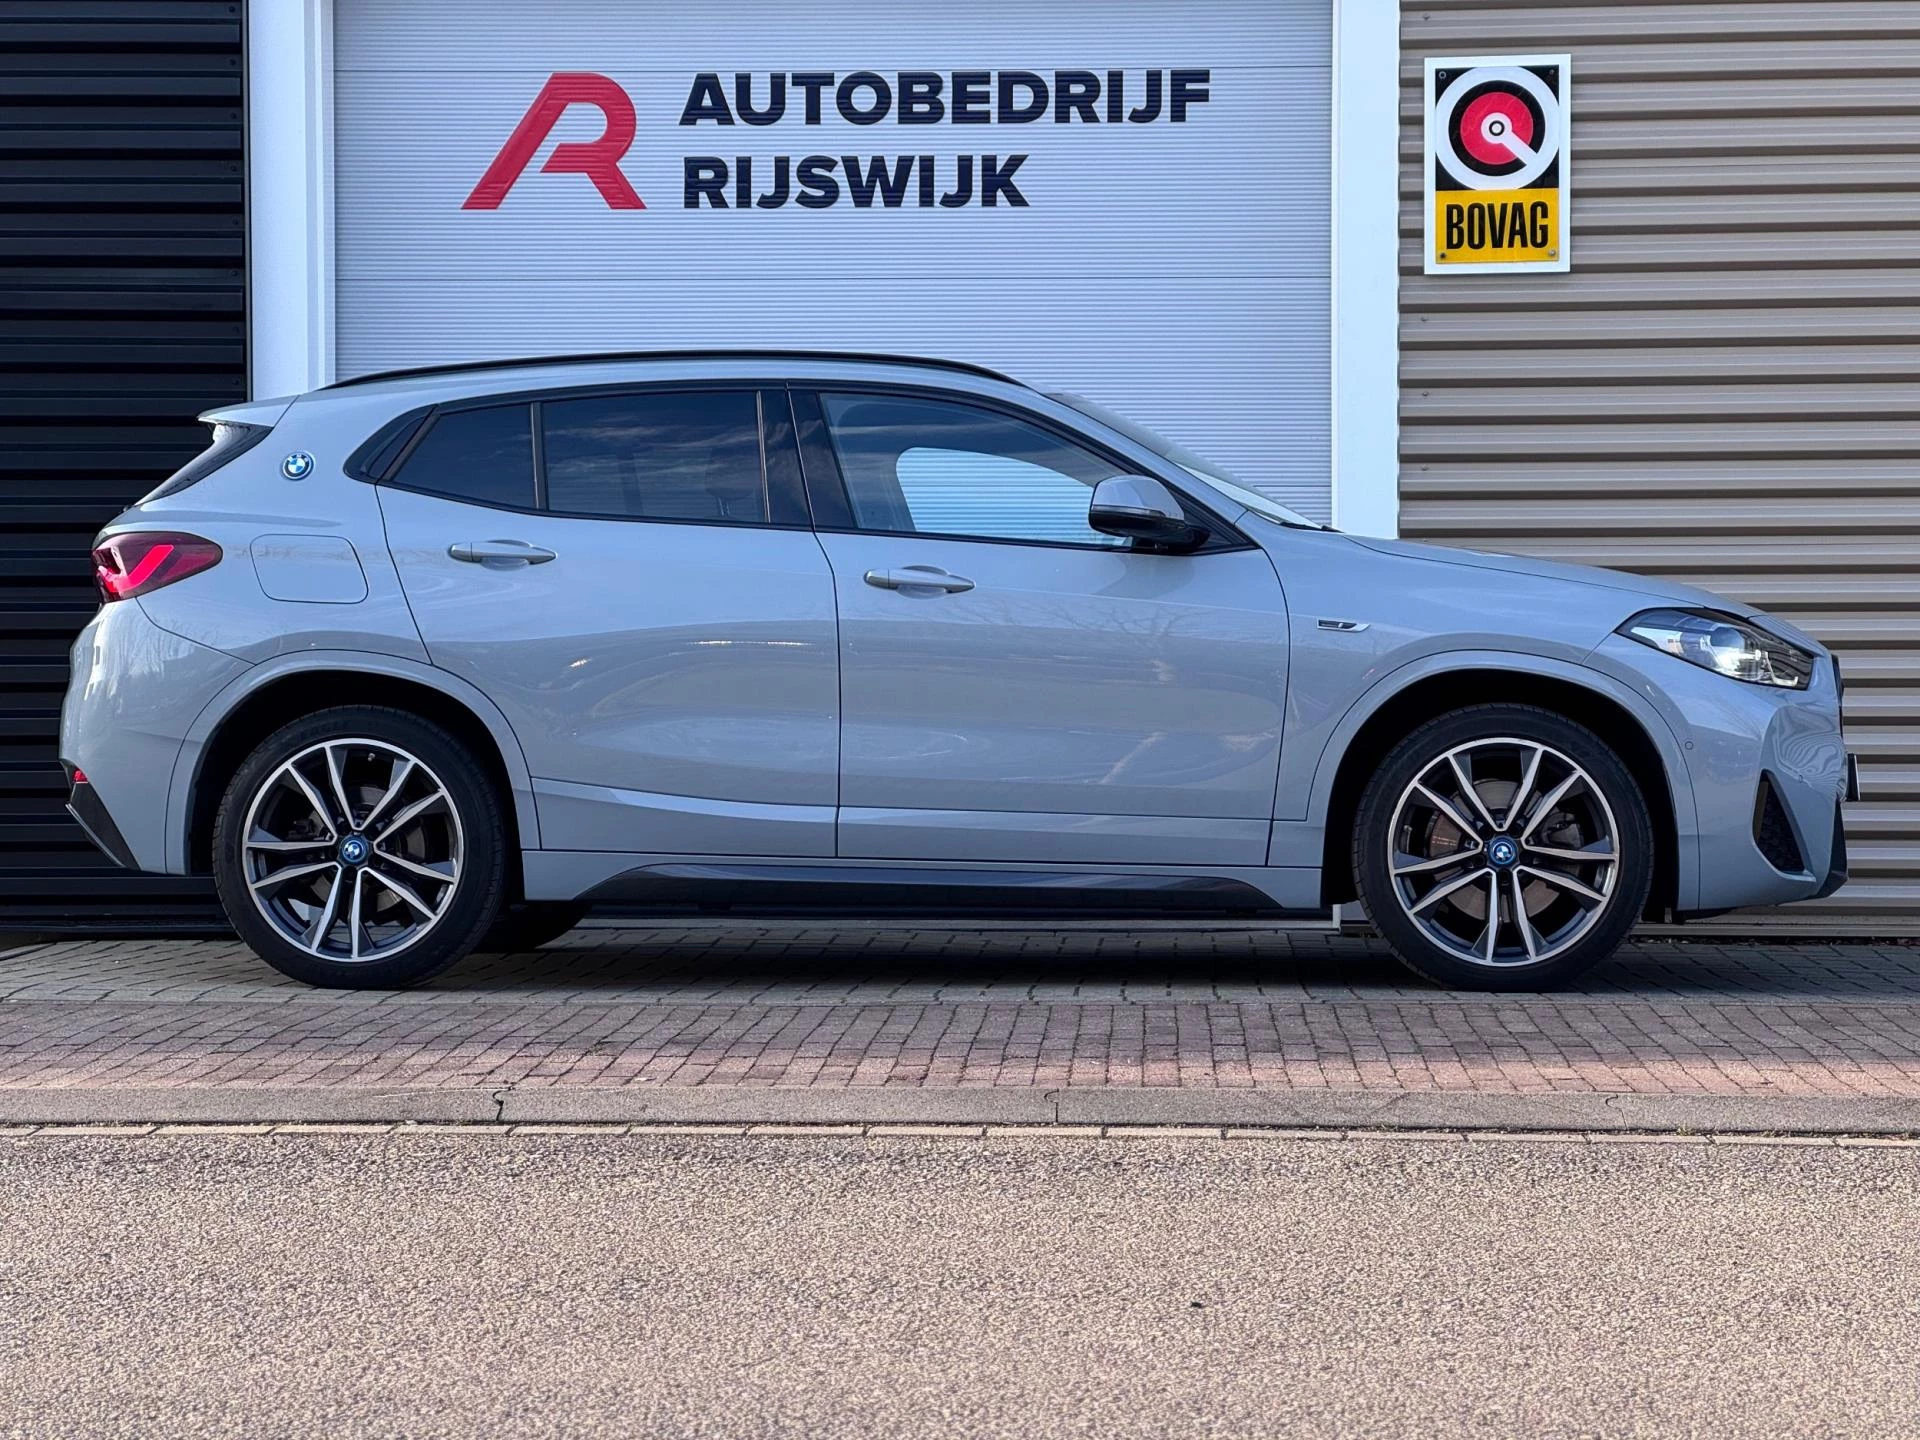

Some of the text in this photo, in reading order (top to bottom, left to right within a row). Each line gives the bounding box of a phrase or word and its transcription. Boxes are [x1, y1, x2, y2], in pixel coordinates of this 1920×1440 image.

[679, 69, 1210, 126] AUTOBEDRIJF
[684, 155, 1029, 209] RIJSWIJK
[1446, 201, 1549, 250] BOVAG
